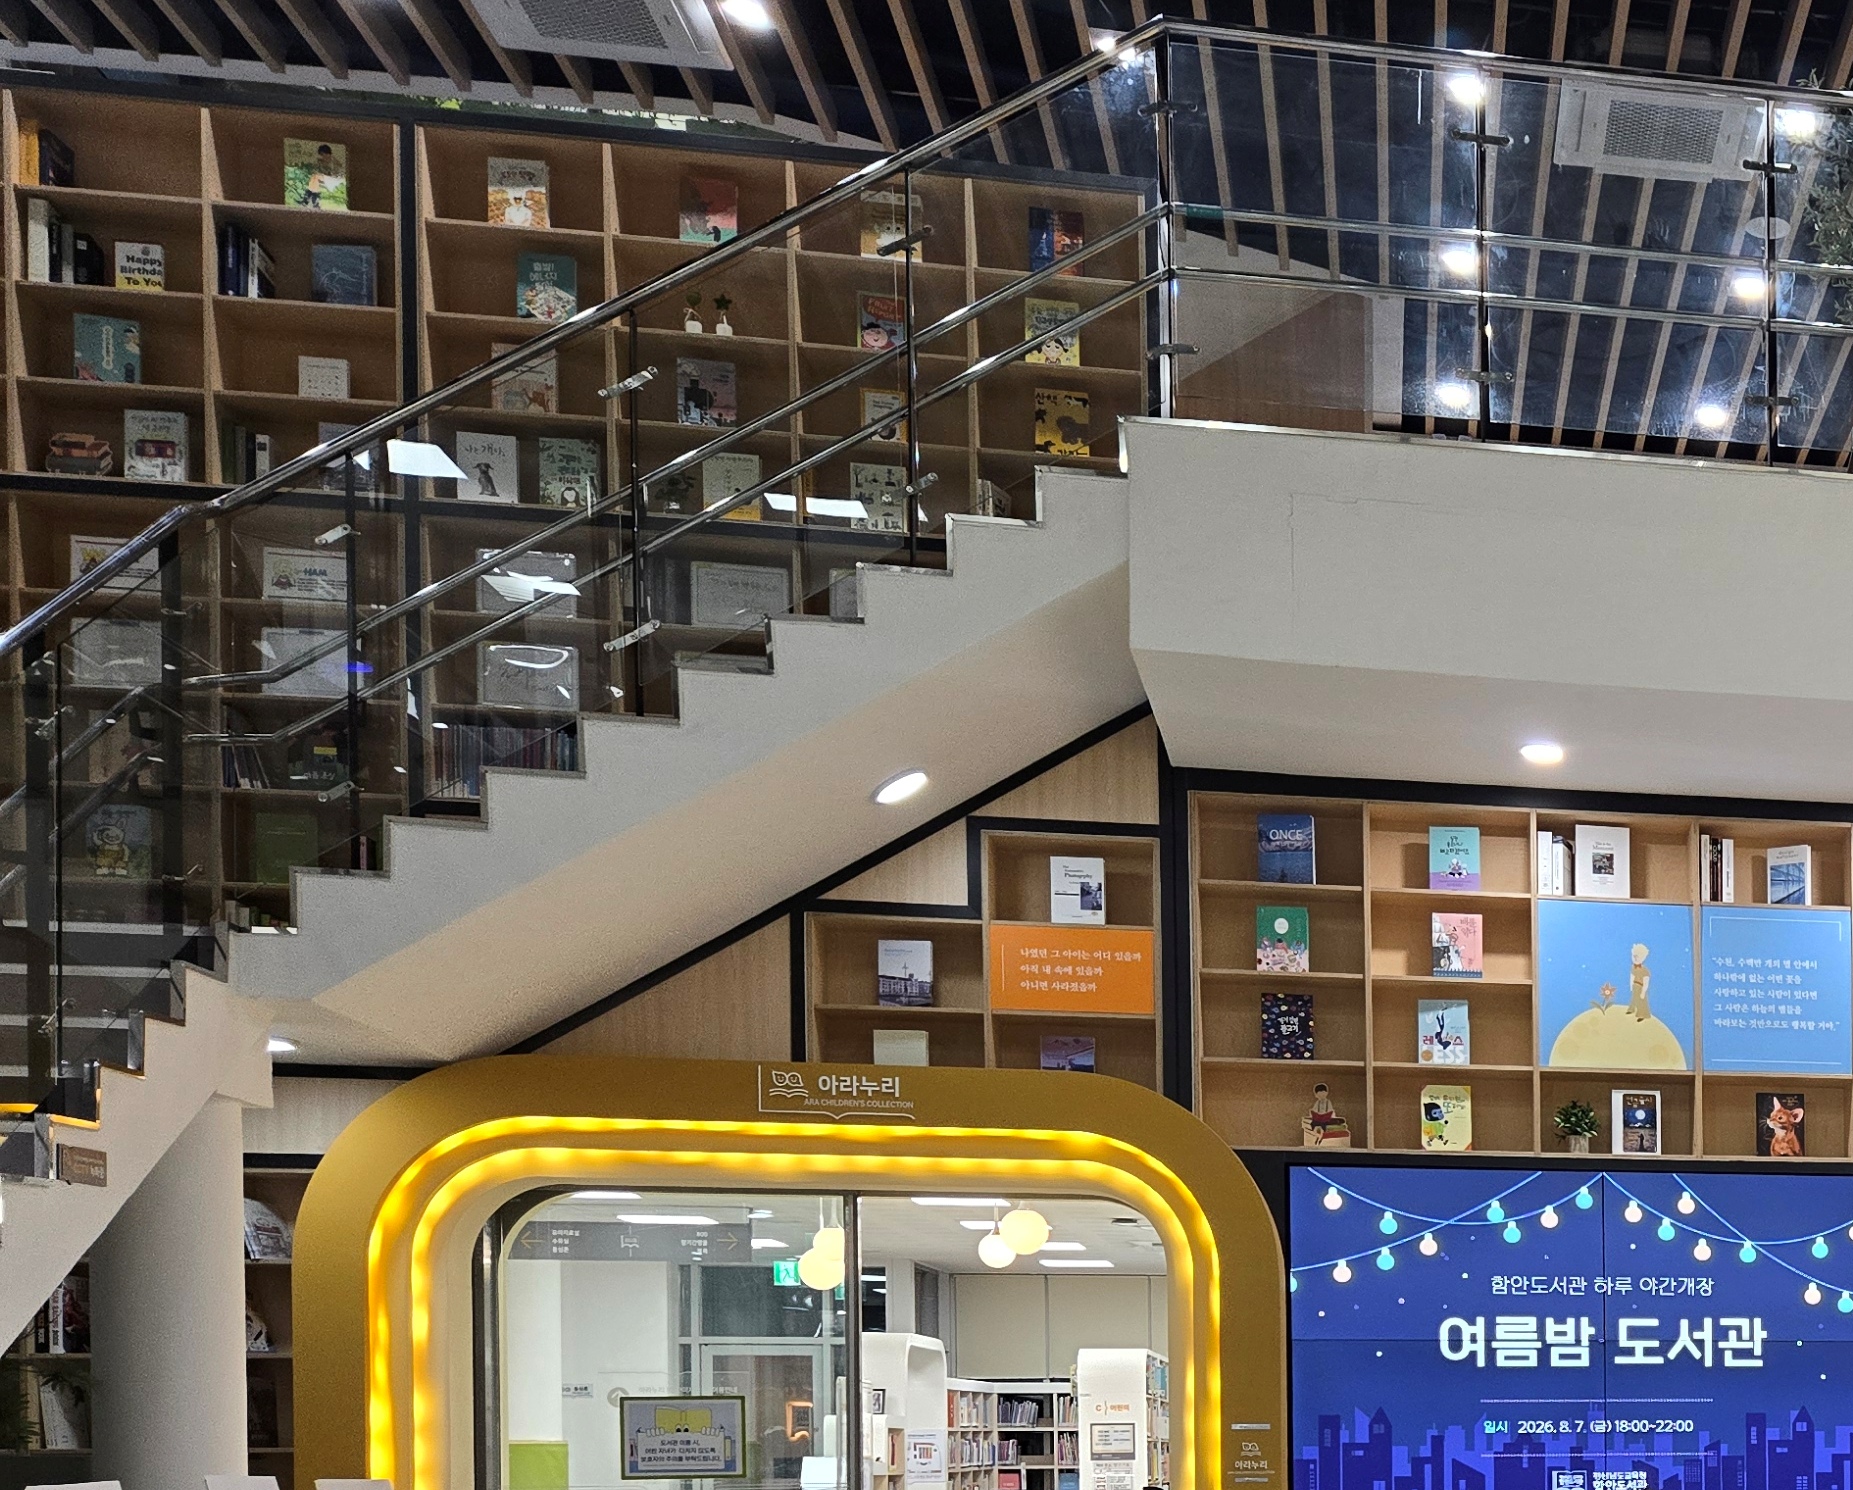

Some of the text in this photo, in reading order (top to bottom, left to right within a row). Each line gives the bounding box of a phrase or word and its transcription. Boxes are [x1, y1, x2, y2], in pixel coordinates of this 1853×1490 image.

[126, 255, 162, 267] Happy
[120, 265, 162, 276] Birthda
[124, 276, 140, 286] To
[1269, 829, 1303, 841] ONCE
[1051, 949, 1060, 958] 그
[1062, 949, 1091, 960] 아이는
[1093, 950, 1111, 961] 어디
[1114, 951, 1142, 962] 있을까
[1020, 963, 1039, 974] 아직
[1042, 964, 1051, 975] 내
[1075, 966, 1104, 977] 있을까
[1793, 959, 1818, 970] 안에서
[1020, 980, 1098, 992] 아니면 사라졌을까
[1748, 988, 1765, 999] 있는
[1793, 990, 1818, 1001] 있다면
[1713, 1004, 1722, 1012] 그
[818, 1075, 900, 1098] 아라누리
[804, 1098, 914, 1109] ARA CHILDREN'S COLLECTION
[1491, 1275, 1715, 1297] 함안도서관 하루 야간개장
[1438, 1315, 1768, 1368] 여름밤 도서관
[1095, 1404, 1102, 1412] C
[1483, 1420, 1509, 1434] 일시
[1517, 1420, 1557, 1434] 2026.
[1559, 1420, 1572, 1434] 8.
[1590, 1419, 1612, 1434] (금)
[1615, 1420, 1694, 1433] 18:00~22:00
